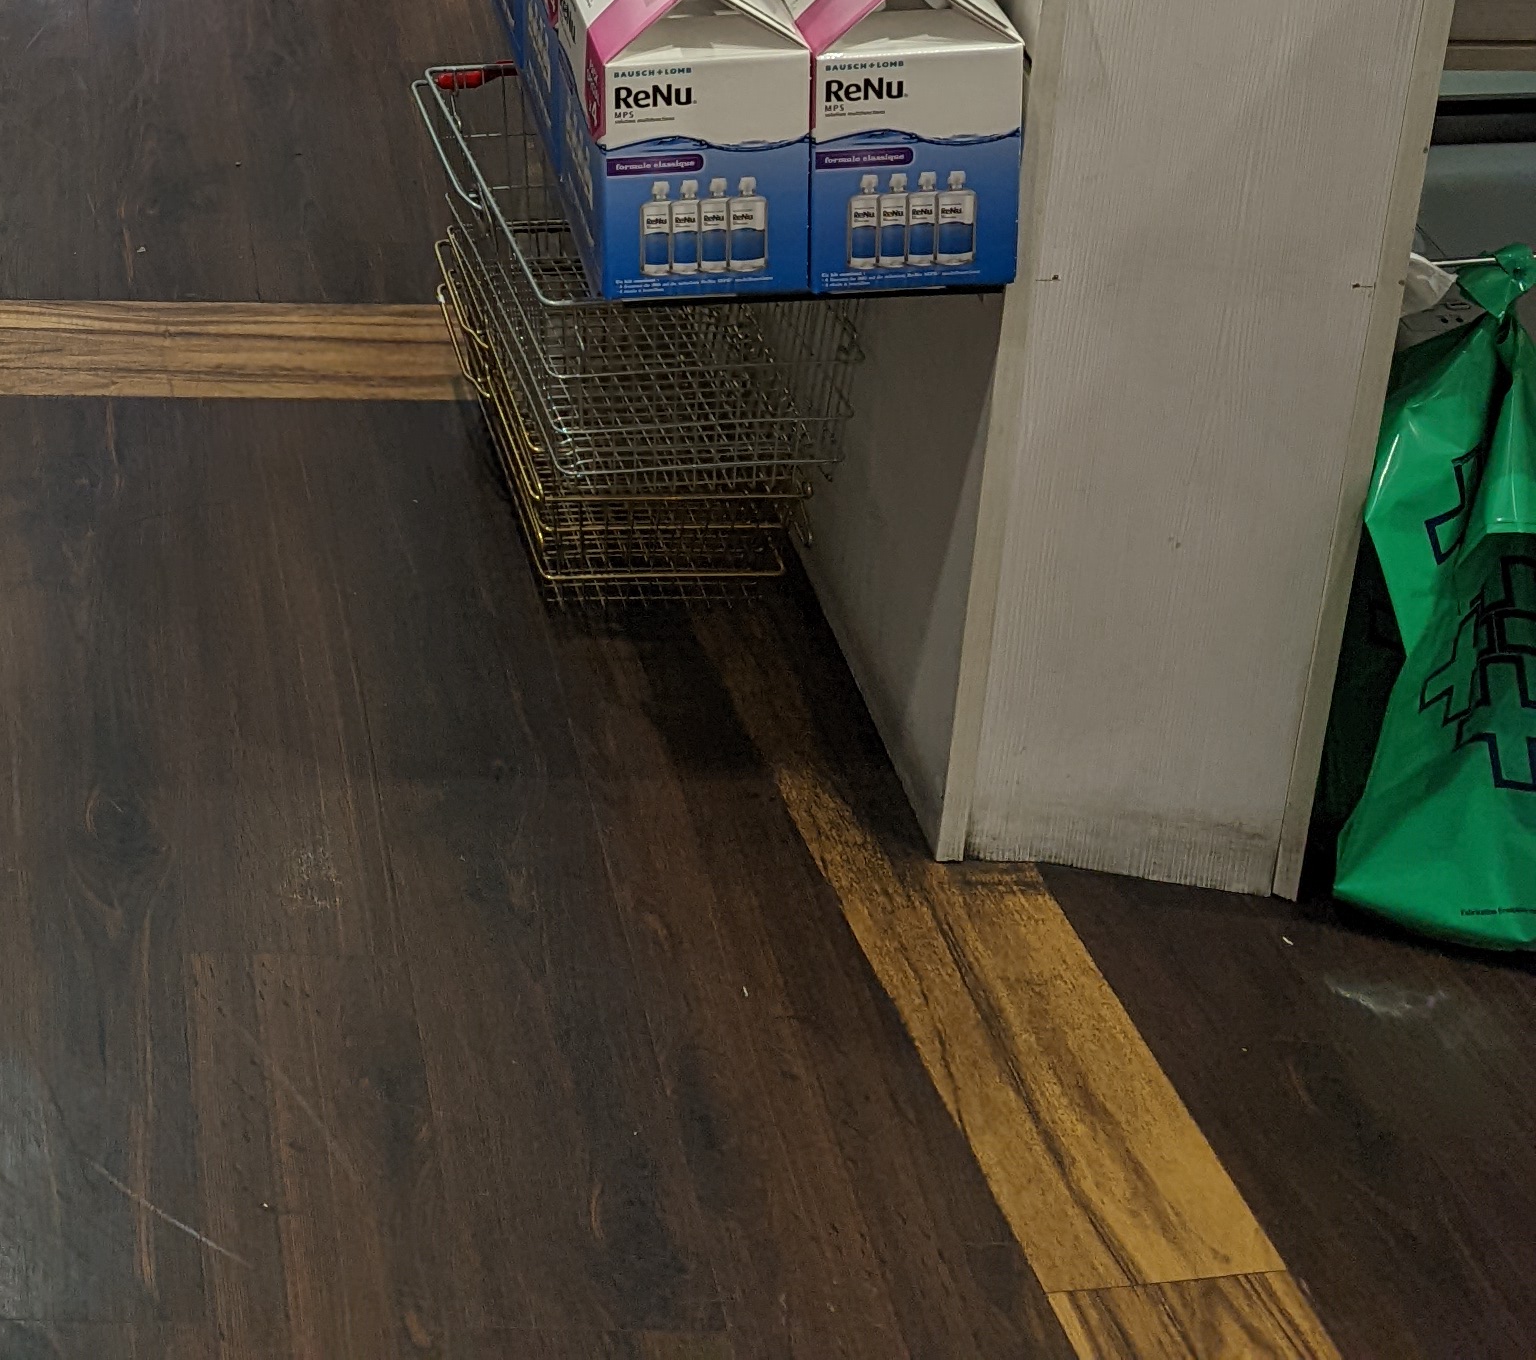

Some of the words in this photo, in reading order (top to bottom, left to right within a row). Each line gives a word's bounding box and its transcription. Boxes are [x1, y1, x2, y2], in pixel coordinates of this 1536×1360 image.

[614, 84, 694, 110] ReNu
[824, 77, 905, 103] ReNu
[614, 110, 635, 119] MPS
[825, 103, 845, 112] MPS
